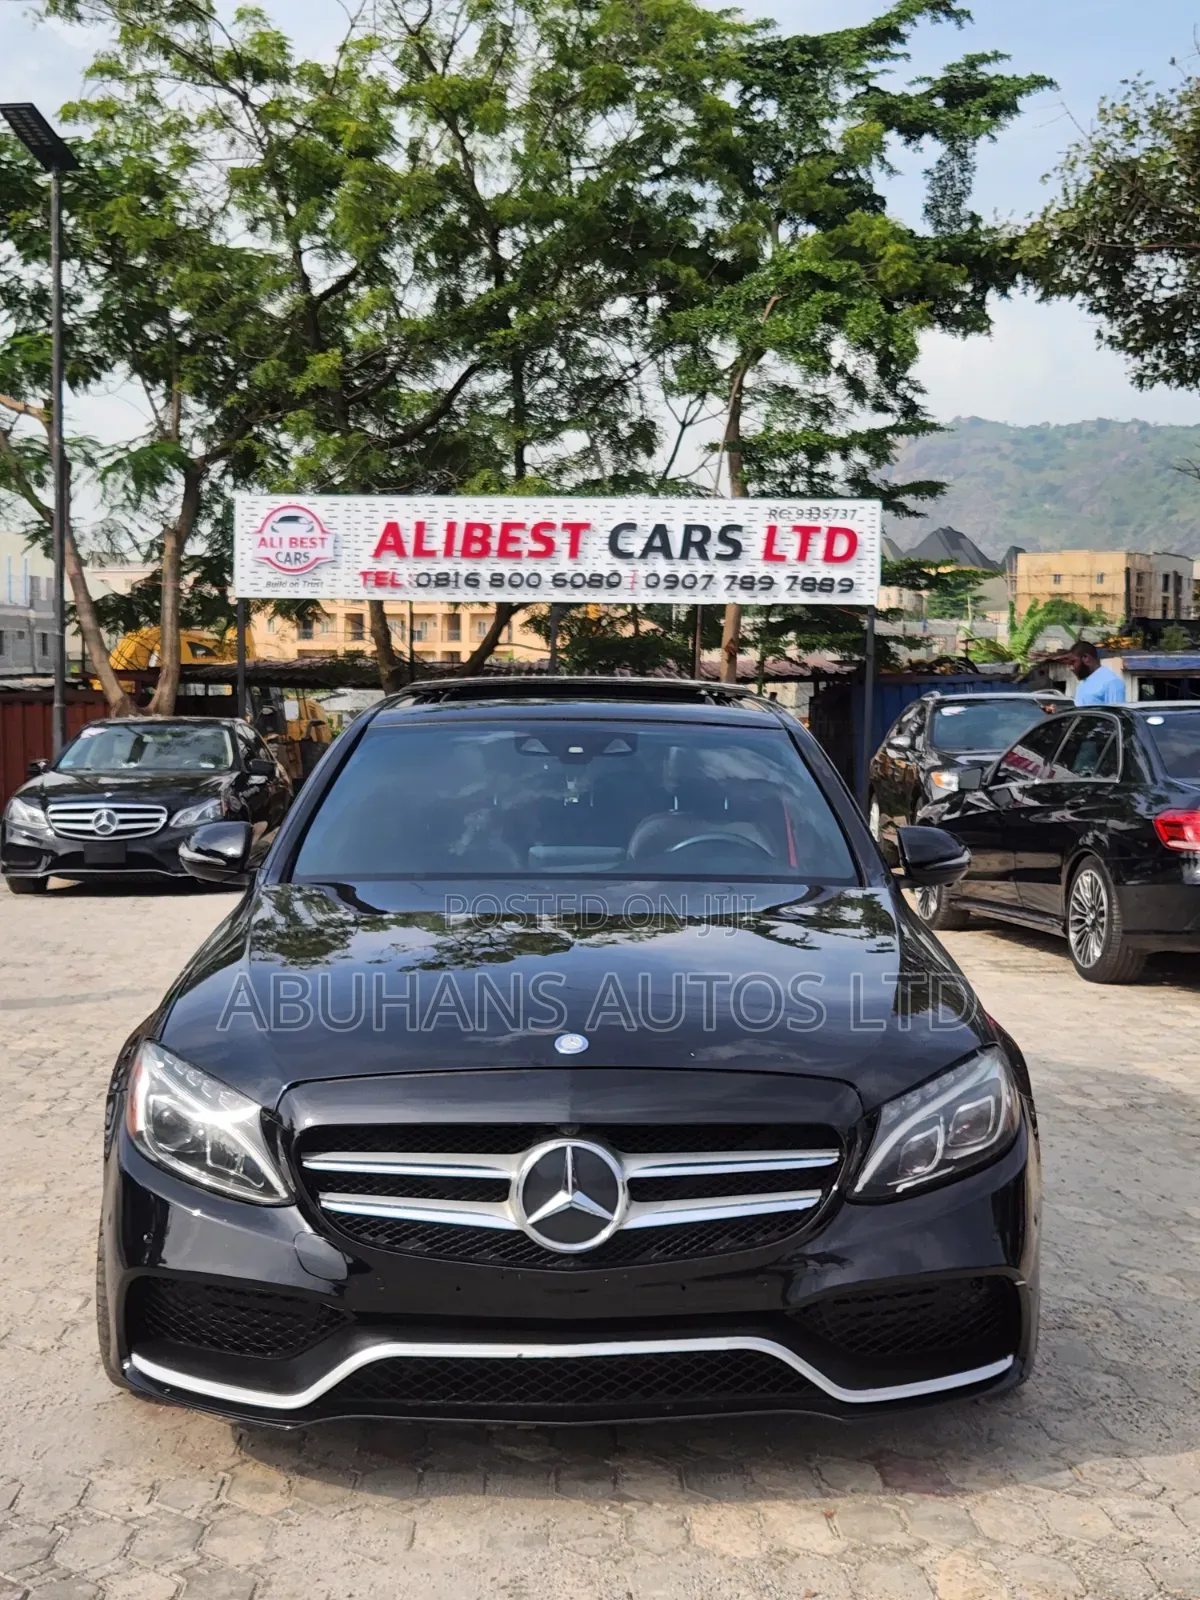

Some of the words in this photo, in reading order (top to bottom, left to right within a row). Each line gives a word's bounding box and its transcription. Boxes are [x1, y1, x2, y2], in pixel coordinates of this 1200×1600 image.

[257, 536, 283, 549] ALI
[289, 536, 328, 549] BEST
[372, 521, 591, 560] ALIBEST
[608, 522, 743, 561] CARS
[763, 525, 858, 563] LTD
[275, 551, 310, 566] CARS
[416, 572, 480, 589] 0816
[489, 572, 542, 589] 800
[552, 572, 622, 589] 6080
[645, 573, 714, 590] 0907
[724, 575, 775, 591] 789
[785, 575, 855, 593] 7889
